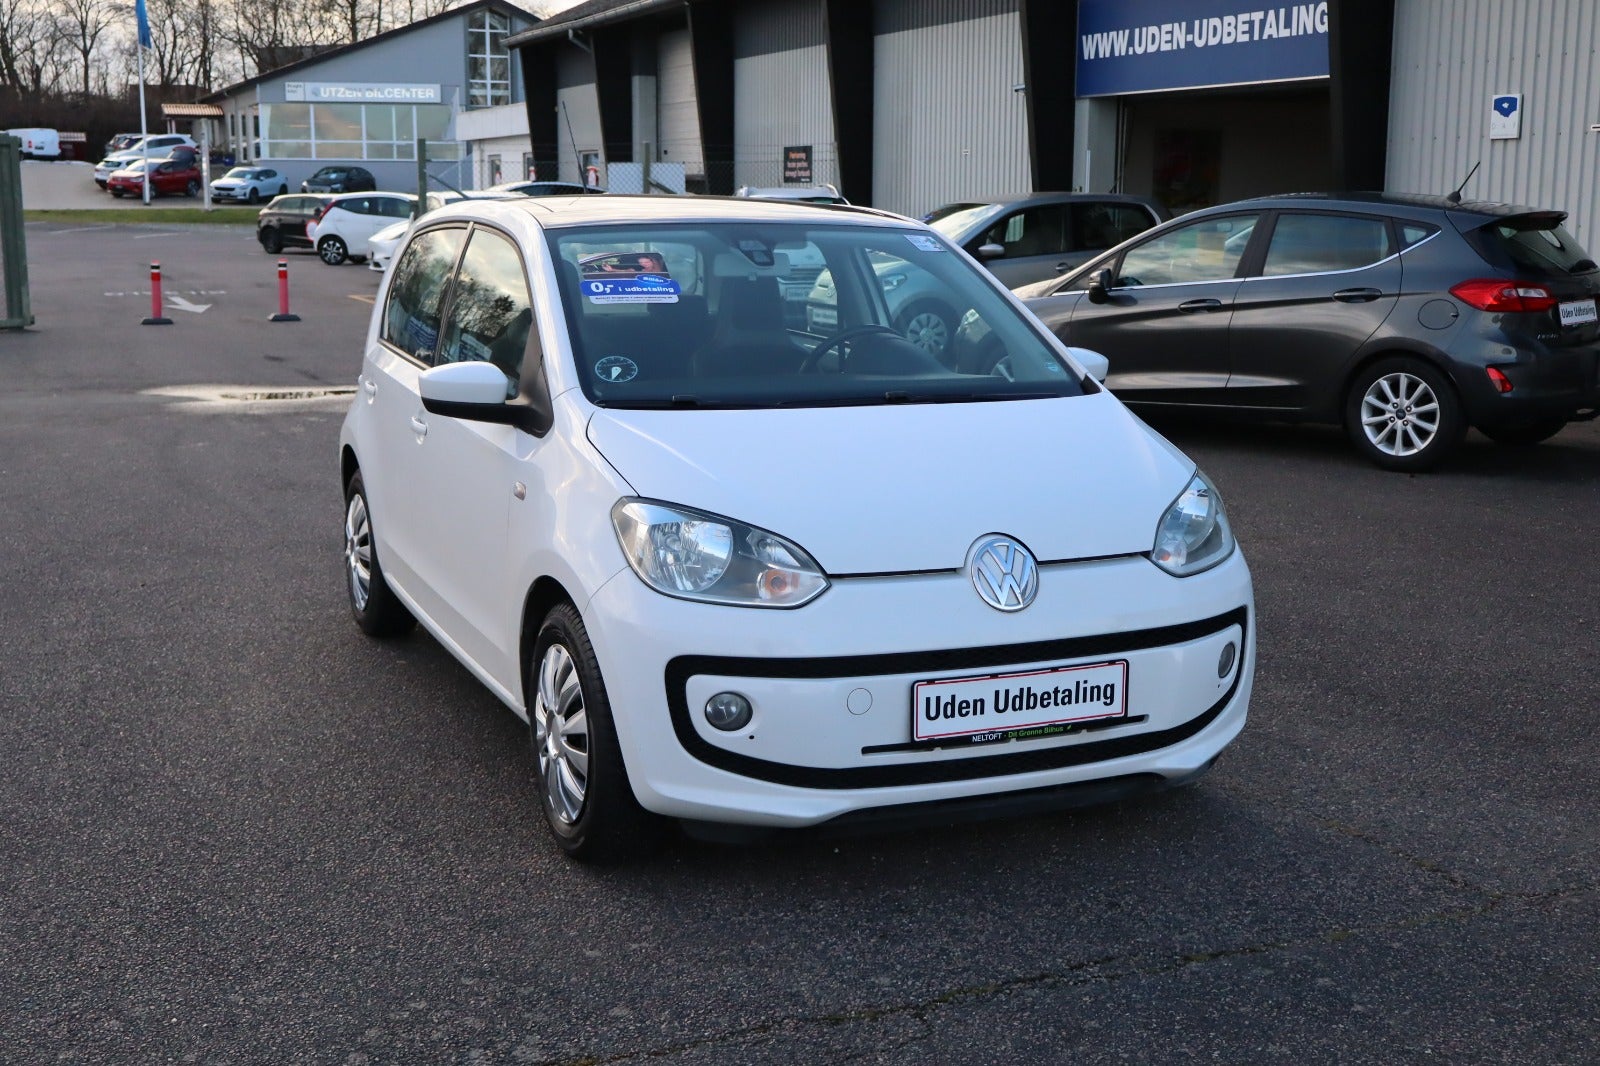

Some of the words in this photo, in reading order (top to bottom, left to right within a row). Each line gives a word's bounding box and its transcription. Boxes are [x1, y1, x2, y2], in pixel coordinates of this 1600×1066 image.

[925, 694, 985, 721] Uden
[993, 680, 1115, 714] Udbetaling
[972, 732, 1002, 742] NELTOFT
